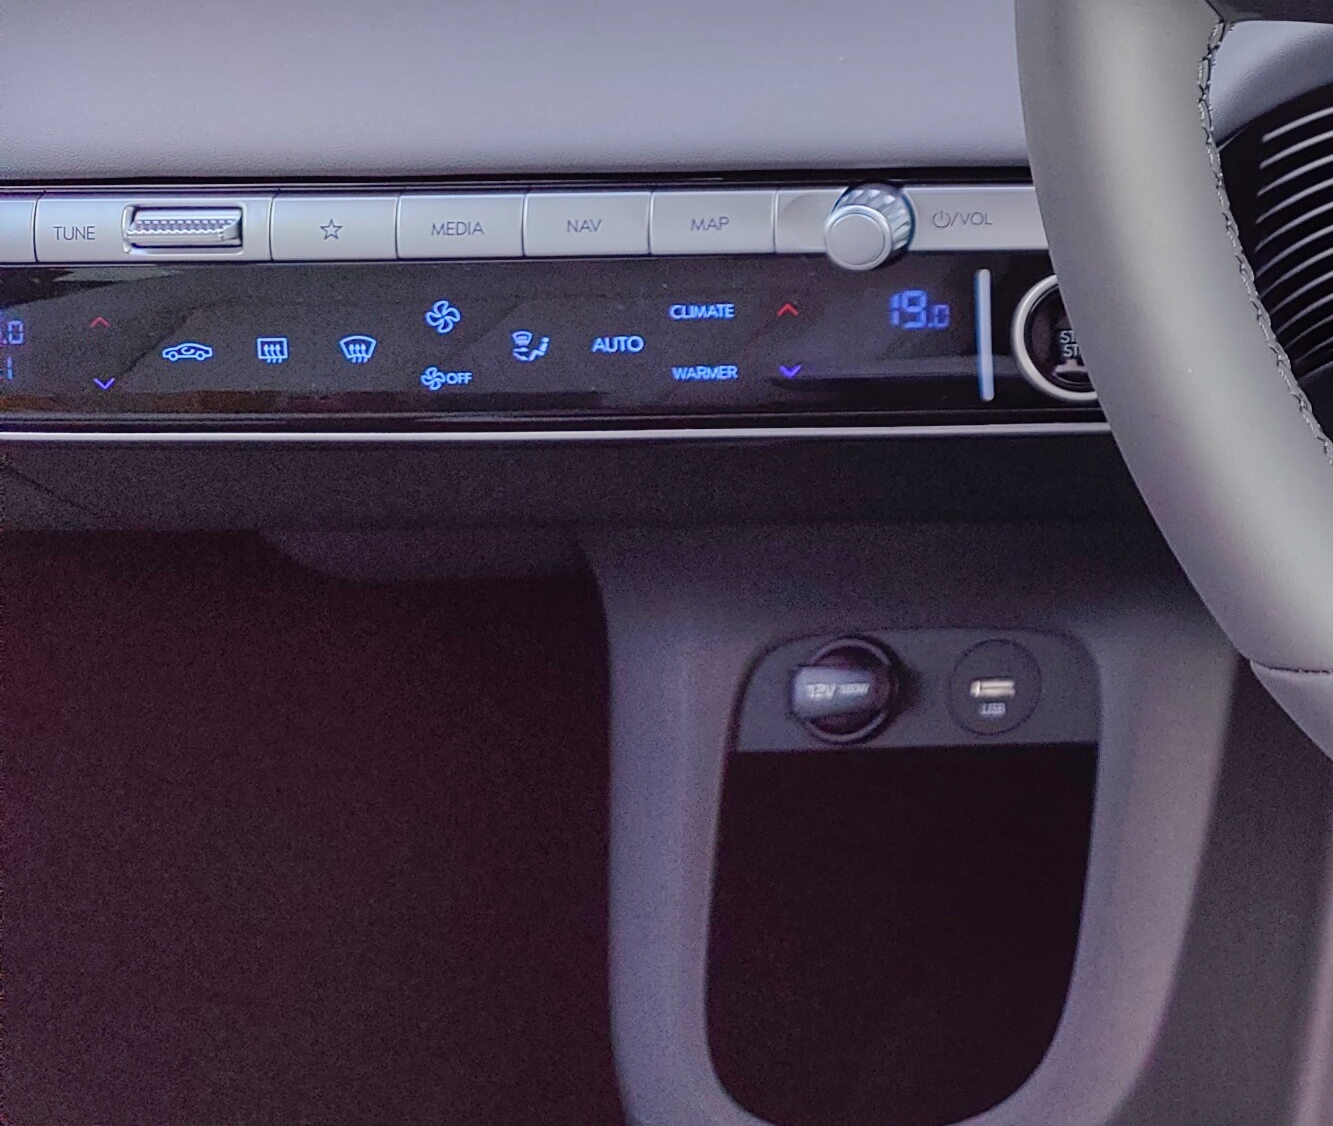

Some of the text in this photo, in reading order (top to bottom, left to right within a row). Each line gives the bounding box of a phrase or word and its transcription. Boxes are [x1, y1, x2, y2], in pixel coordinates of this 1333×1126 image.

[430, 220, 485, 238] MEDIA
[566, 218, 603, 234] NAV
[690, 216, 731, 232] MAP
[52, 225, 96, 242] TUNE
[668, 302, 736, 320] CLIMATE
[591, 335, 645, 354] AUTO
[446, 372, 473, 385] OFF
[671, 364, 739, 381] WARMER
